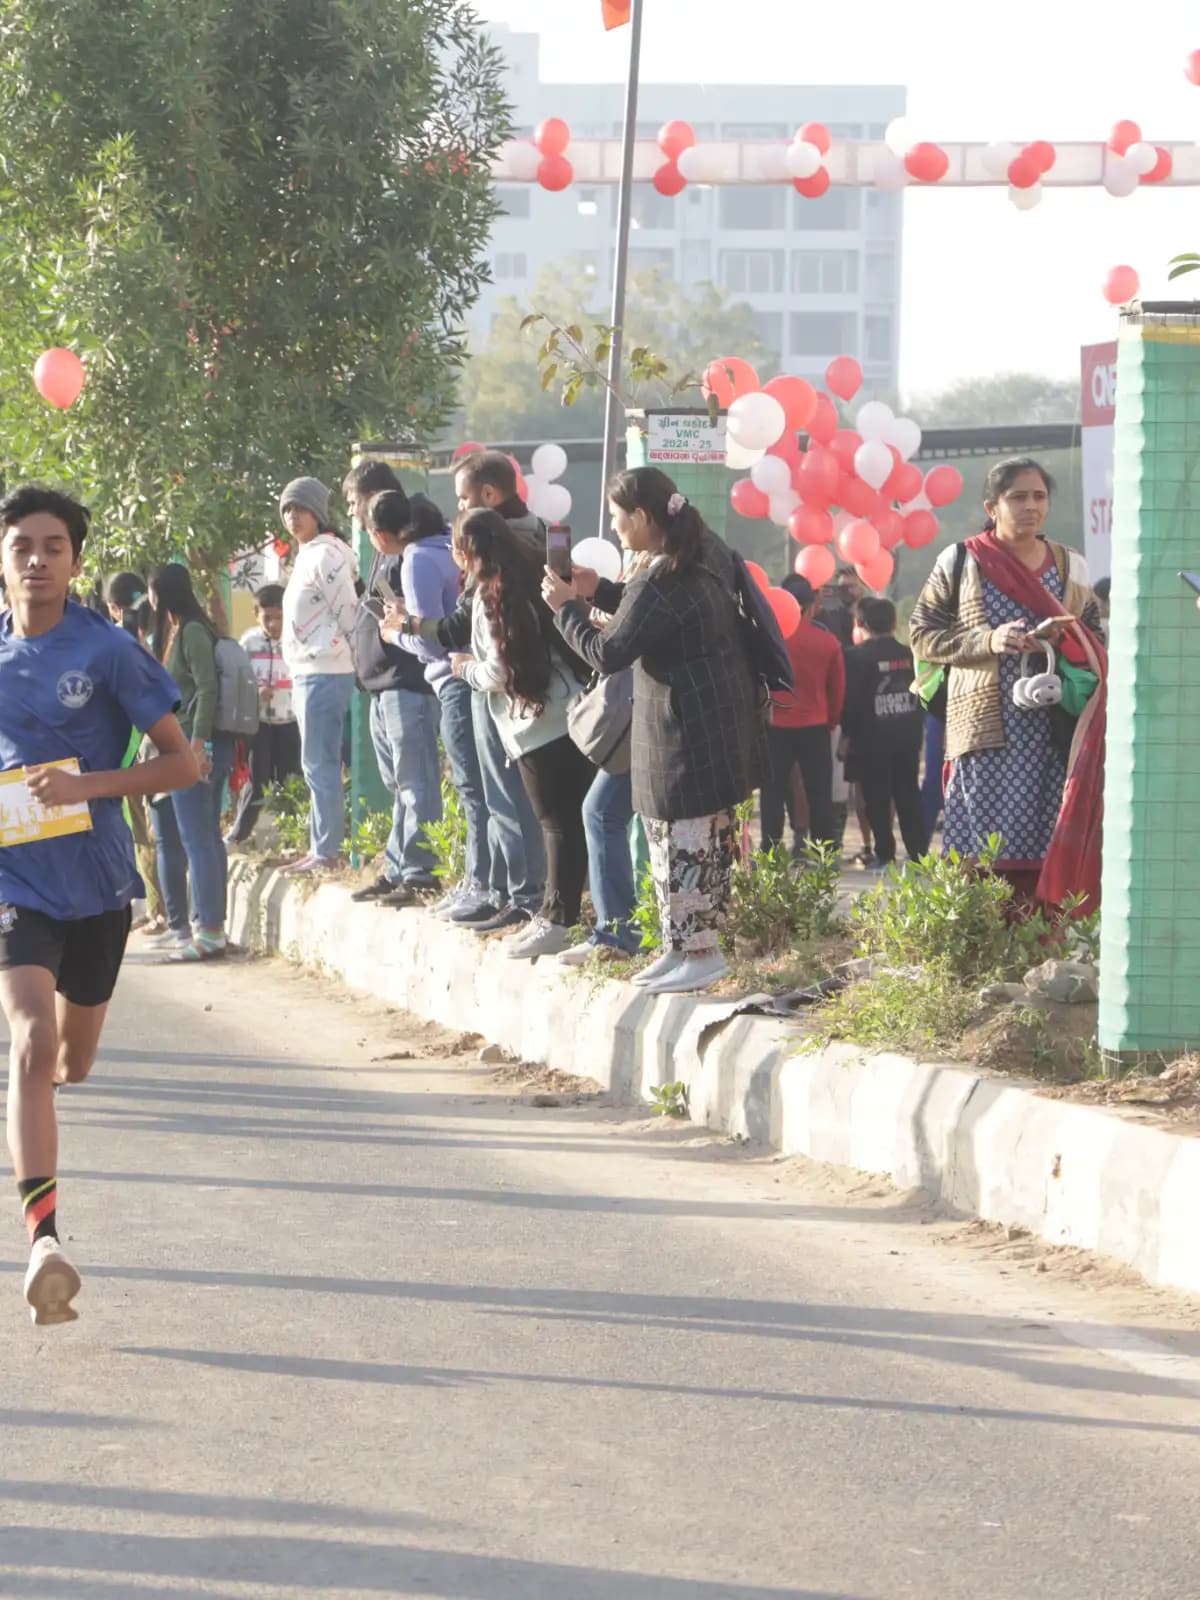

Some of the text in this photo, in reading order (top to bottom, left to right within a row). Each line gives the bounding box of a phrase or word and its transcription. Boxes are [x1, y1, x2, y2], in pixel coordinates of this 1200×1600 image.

[675, 429, 700, 438] VMC
[662, 440, 689, 448] 2024
[700, 440, 712, 449] 25
